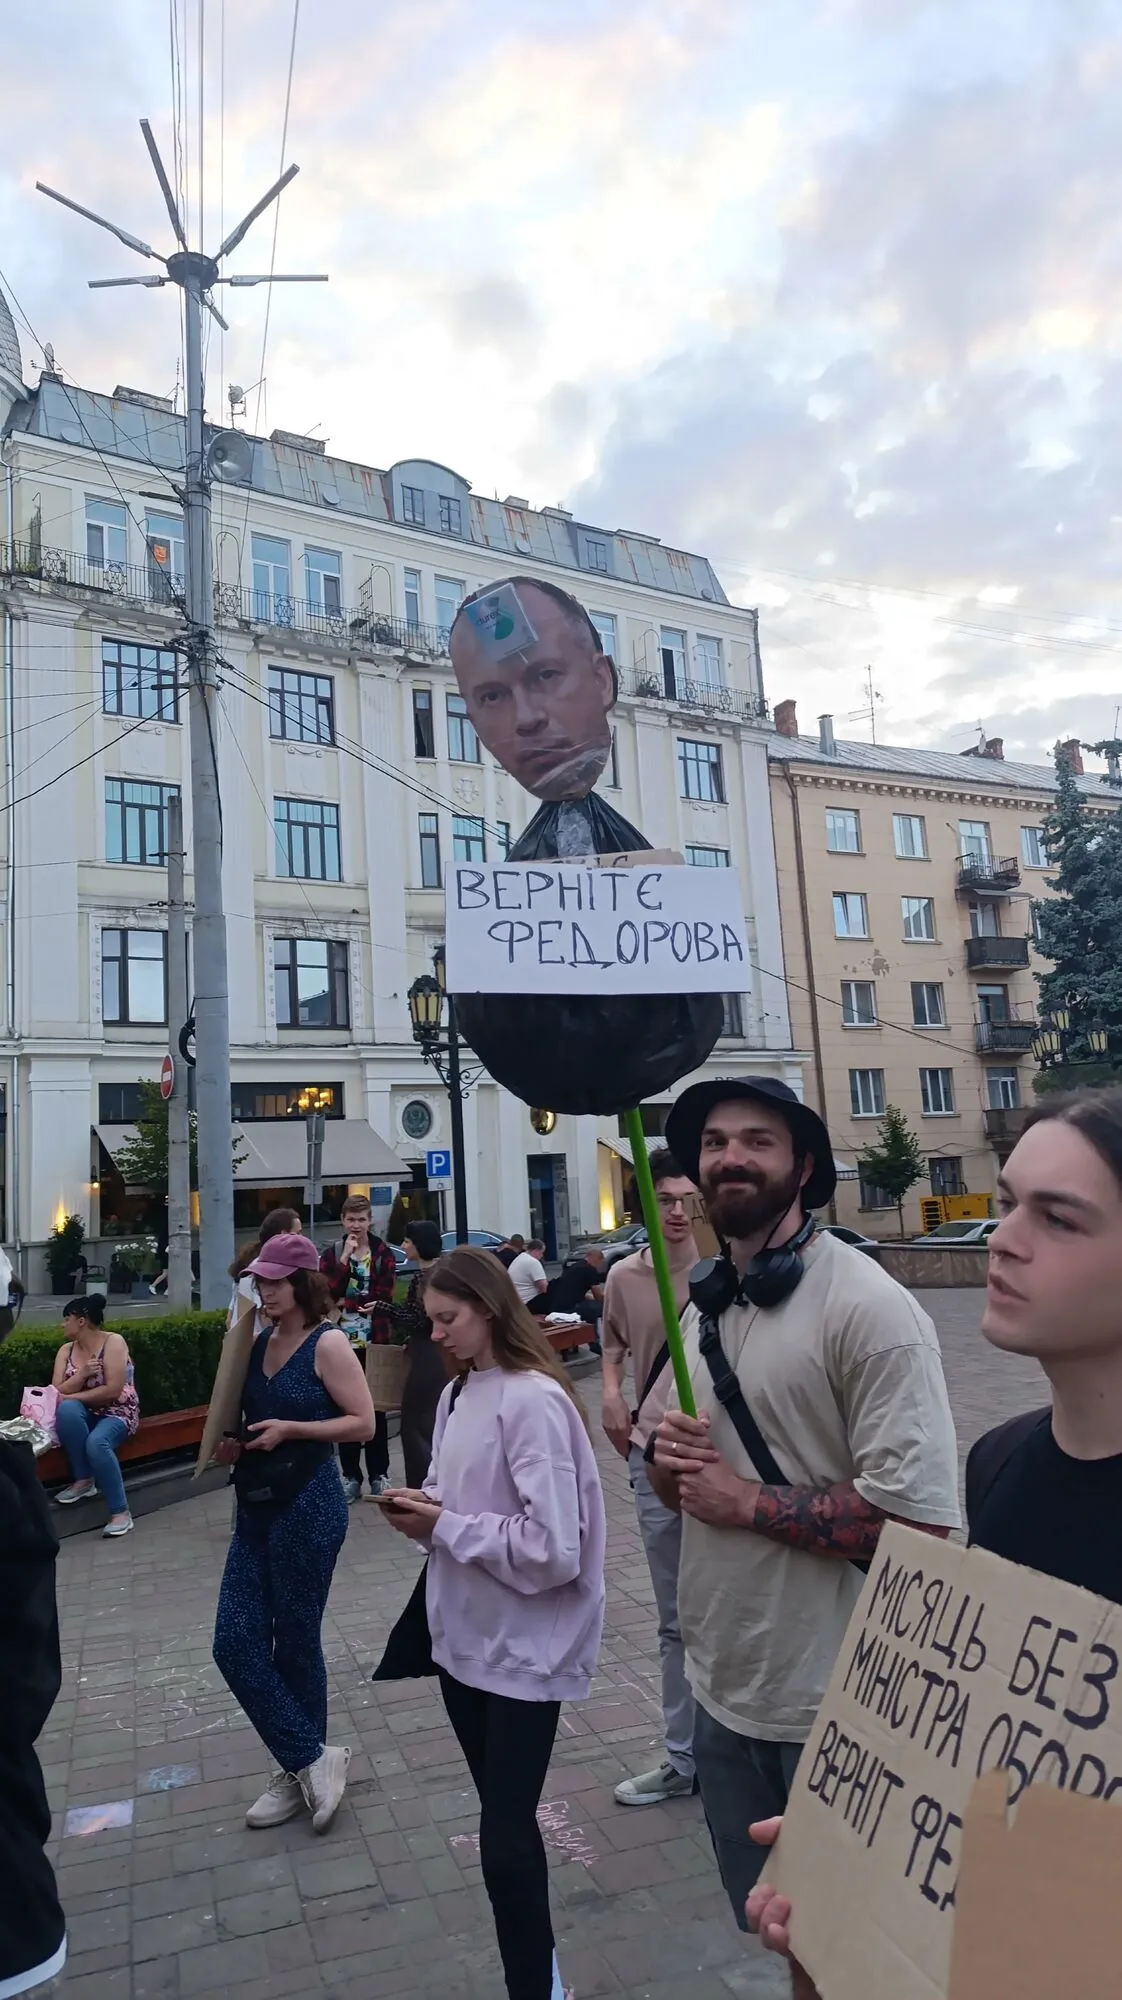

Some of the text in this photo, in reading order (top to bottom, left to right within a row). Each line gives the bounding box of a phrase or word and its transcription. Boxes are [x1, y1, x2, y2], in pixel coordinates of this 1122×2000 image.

[487, 920, 743, 969] ФЕДОРОВА
[432, 1153, 445, 1174] P
[843, 1633, 971, 1768] МІНІСТРА
[866, 1555, 1120, 1730] МІСЯЦЬ БЕЗ
[807, 1720, 964, 1911] ВЕРНІТ ФЕ
